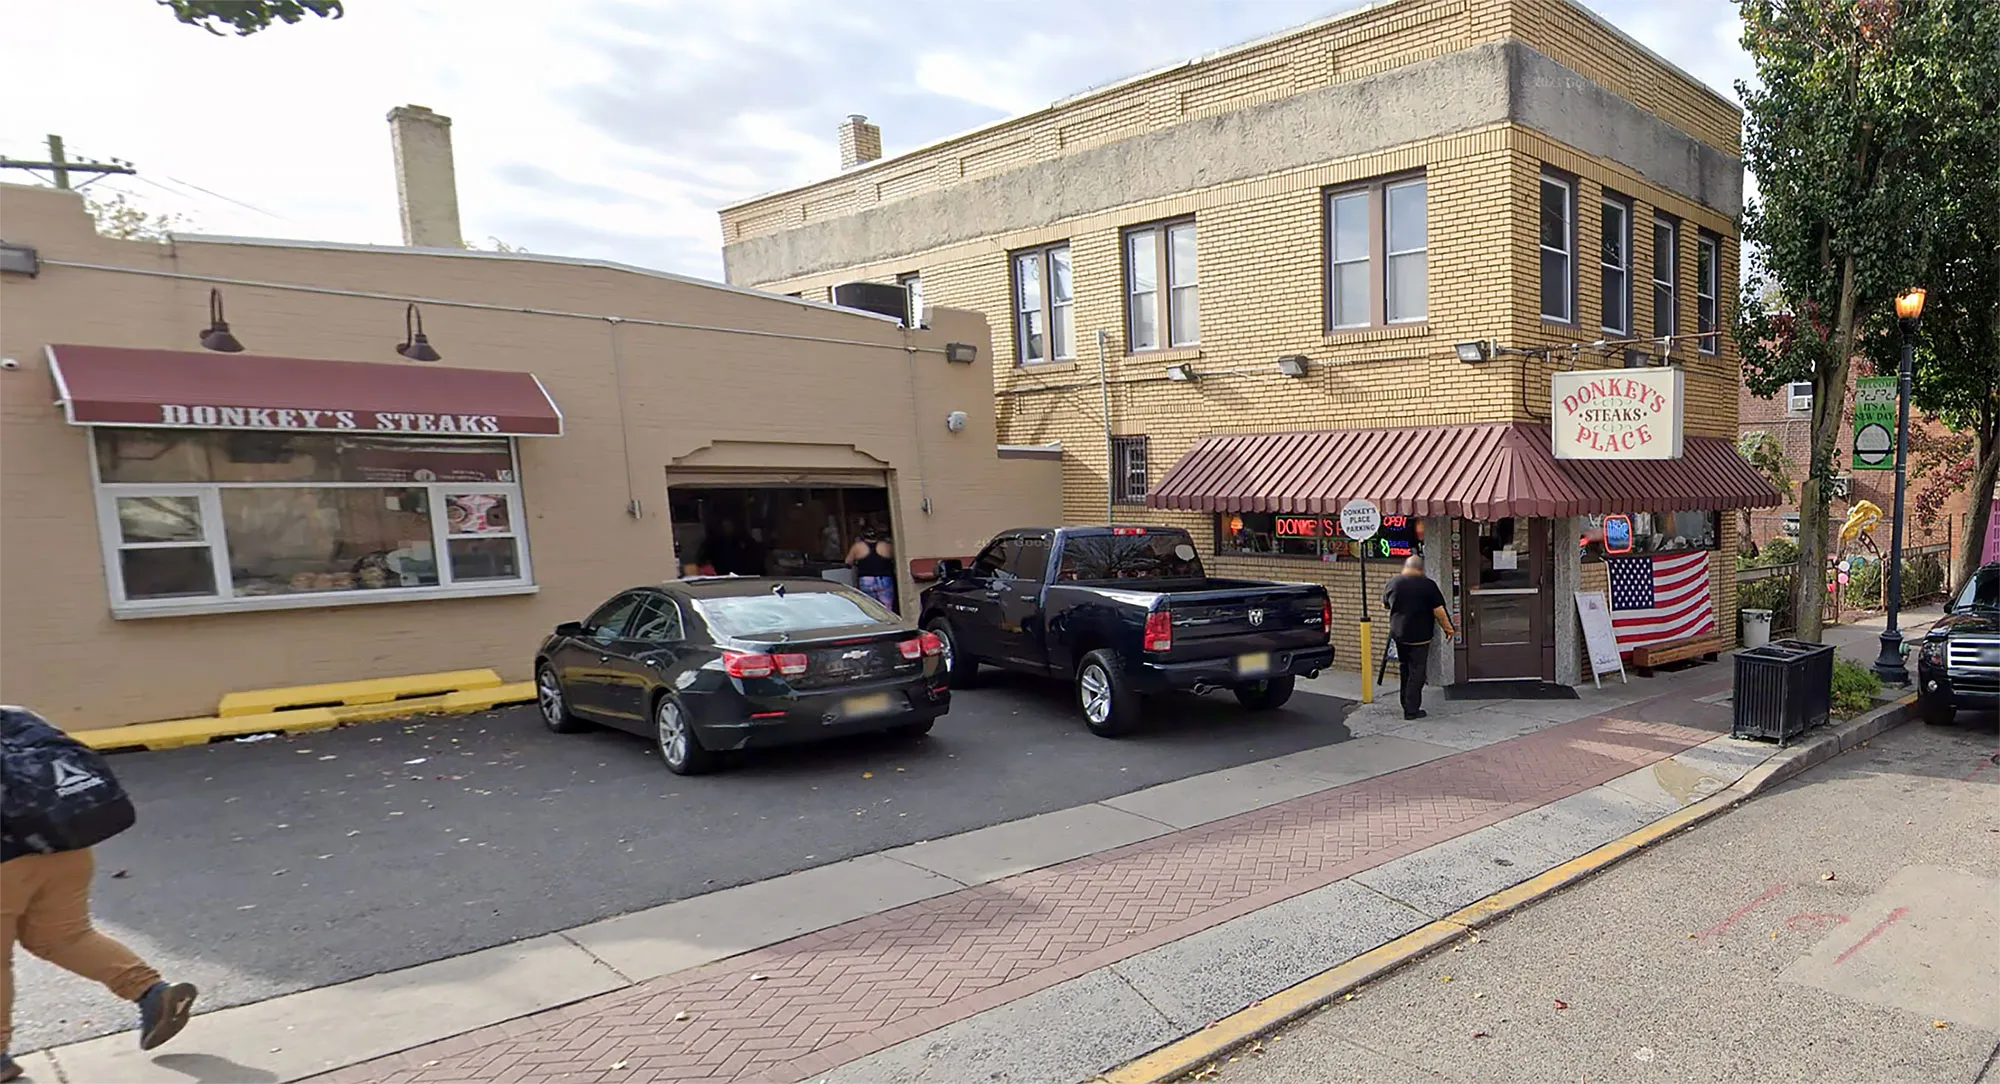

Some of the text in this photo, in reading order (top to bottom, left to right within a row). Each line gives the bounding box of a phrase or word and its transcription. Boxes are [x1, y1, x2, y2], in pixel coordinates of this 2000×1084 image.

[1561, 377, 1666, 416] DONKEY'S
[1879, 403, 1886, 411] A
[160, 404, 500, 433] DONKEY'S STEAKS
[1584, 408, 1642, 422] STEAKS
[1855, 412, 1893, 421] NEW DAY
[1575, 423, 1653, 453] PLACE
[1343, 507, 1376, 516] DONKEY'S
[1349, 516, 1371, 524] PLACE
[1383, 515, 1407, 528] OPEN
[1277, 518, 1333, 537] DONKE'S
[1346, 524, 1376, 533] PARKING
